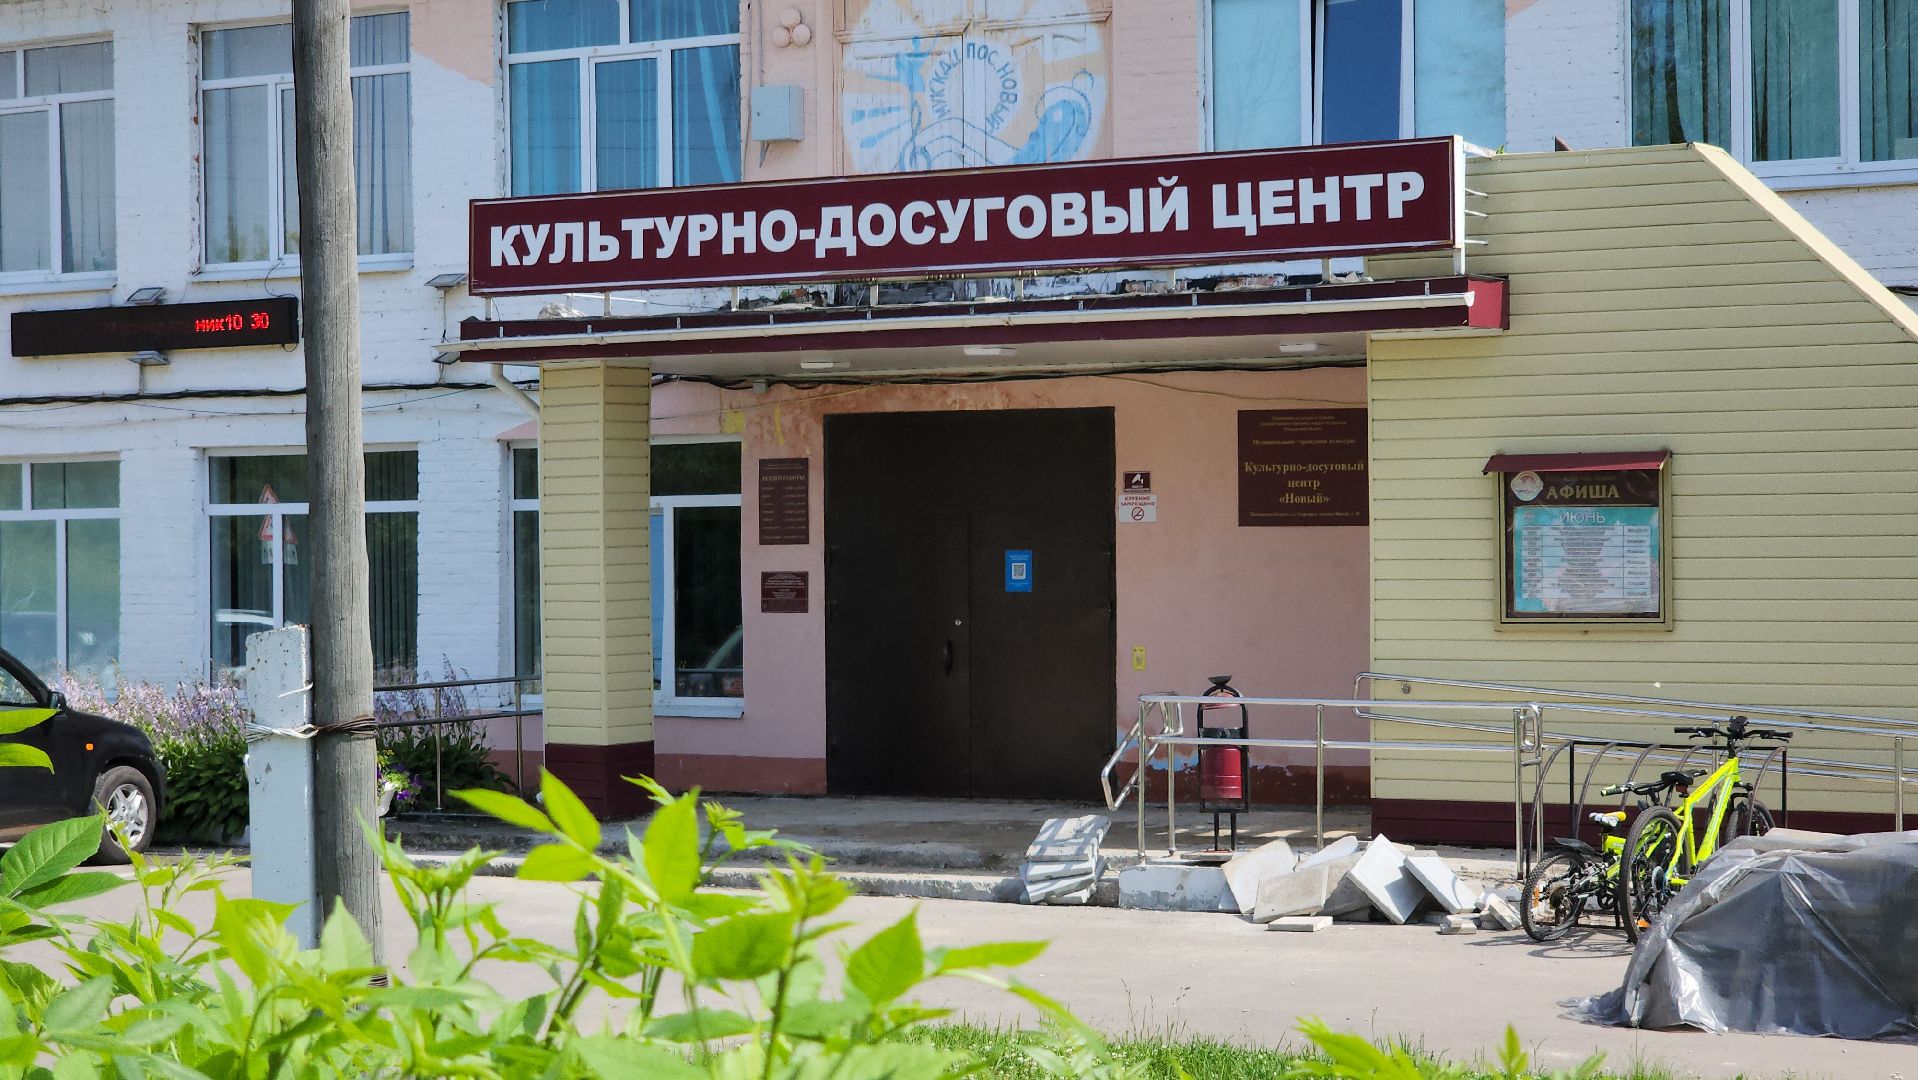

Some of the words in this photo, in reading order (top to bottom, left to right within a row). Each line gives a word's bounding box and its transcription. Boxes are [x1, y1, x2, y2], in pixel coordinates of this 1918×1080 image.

[490, 175, 1189, 267] КУЛЬТУРНО-ДОСУГОВЫЙ
[1212, 171, 1425, 236] ЦЕНТР
[250, 312, 270, 329] 30
[1244, 461, 1365, 475] Культурно-досуговый
[1288, 480, 1321, 490] центр
[1545, 484, 1620, 500] АФИША
[1279, 493, 1330, 504] «Новый»
[1559, 511, 1606, 523] ИЮНЬ
